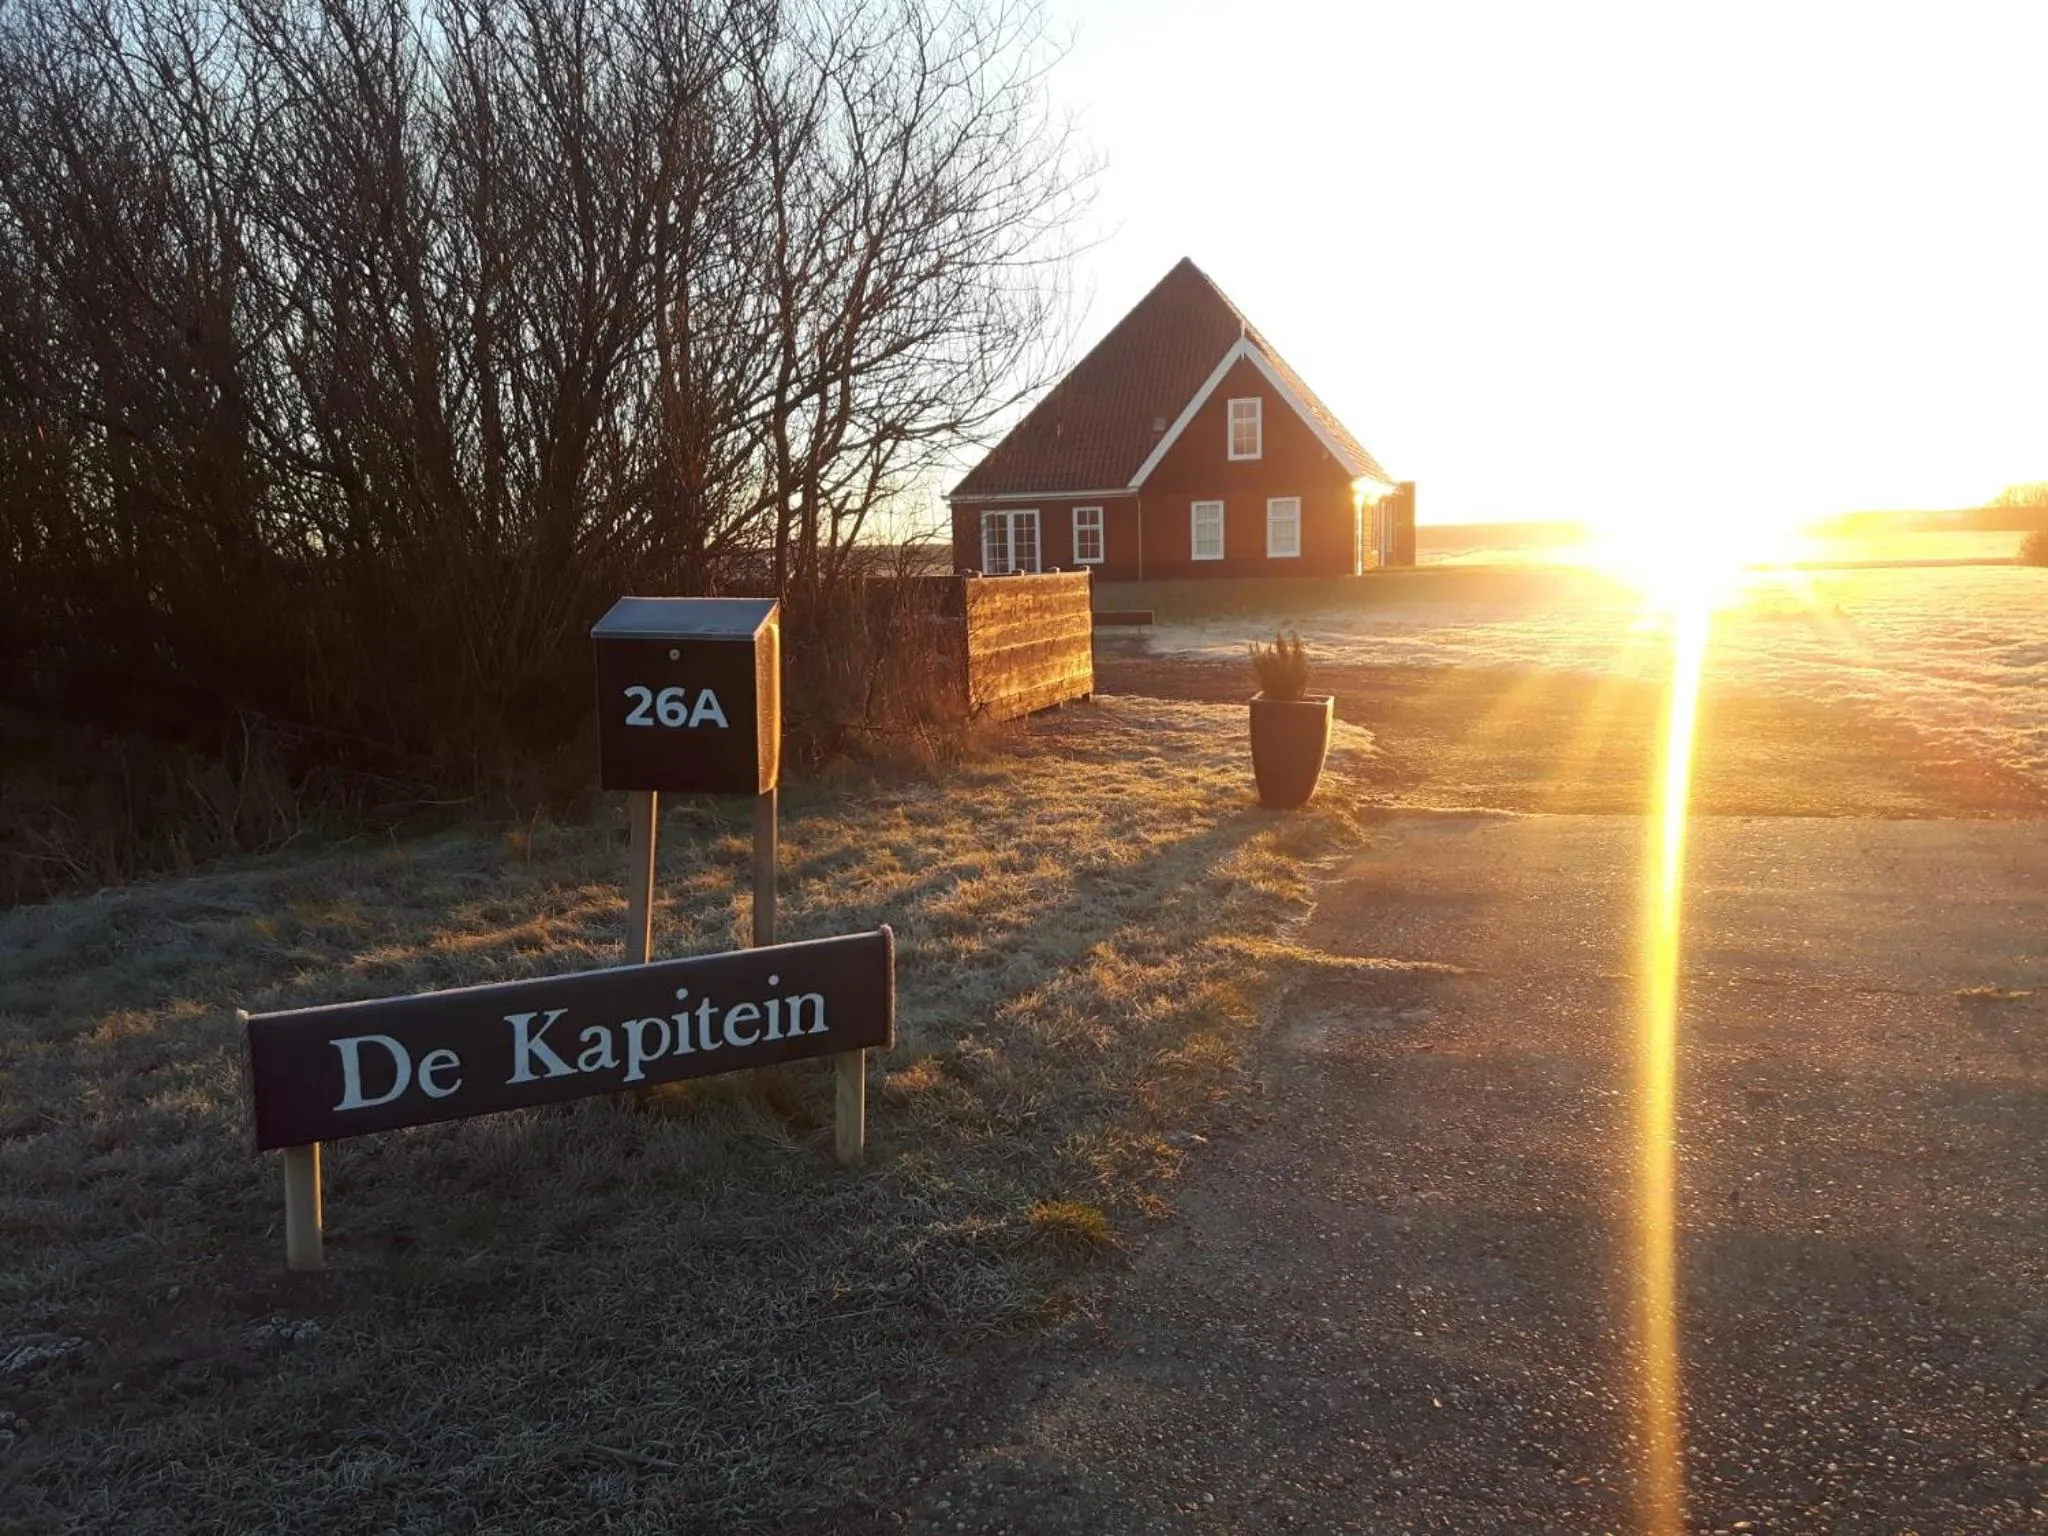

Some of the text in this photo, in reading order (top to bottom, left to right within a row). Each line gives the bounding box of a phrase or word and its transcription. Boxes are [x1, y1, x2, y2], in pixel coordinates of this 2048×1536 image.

[624, 685, 729, 728] 26A
[329, 974, 830, 1111] De Kapitein
